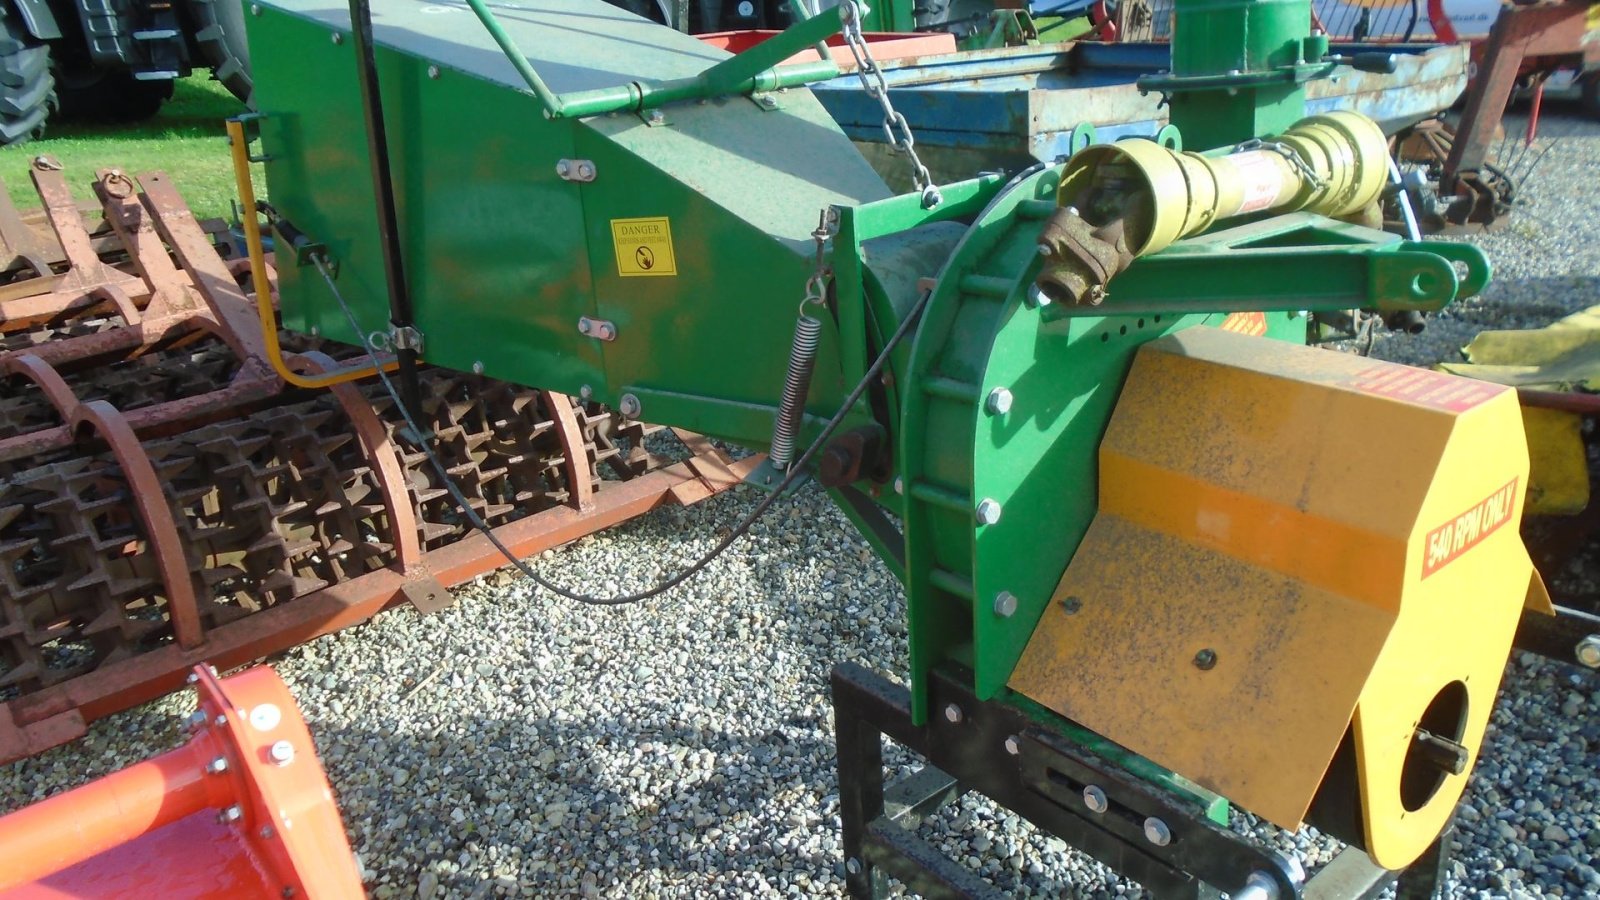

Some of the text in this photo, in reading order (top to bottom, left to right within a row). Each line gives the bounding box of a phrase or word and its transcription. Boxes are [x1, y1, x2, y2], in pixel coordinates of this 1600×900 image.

[621, 225, 660, 235] DANGER
[1427, 482, 1515, 568] 540 RPM ONLY
